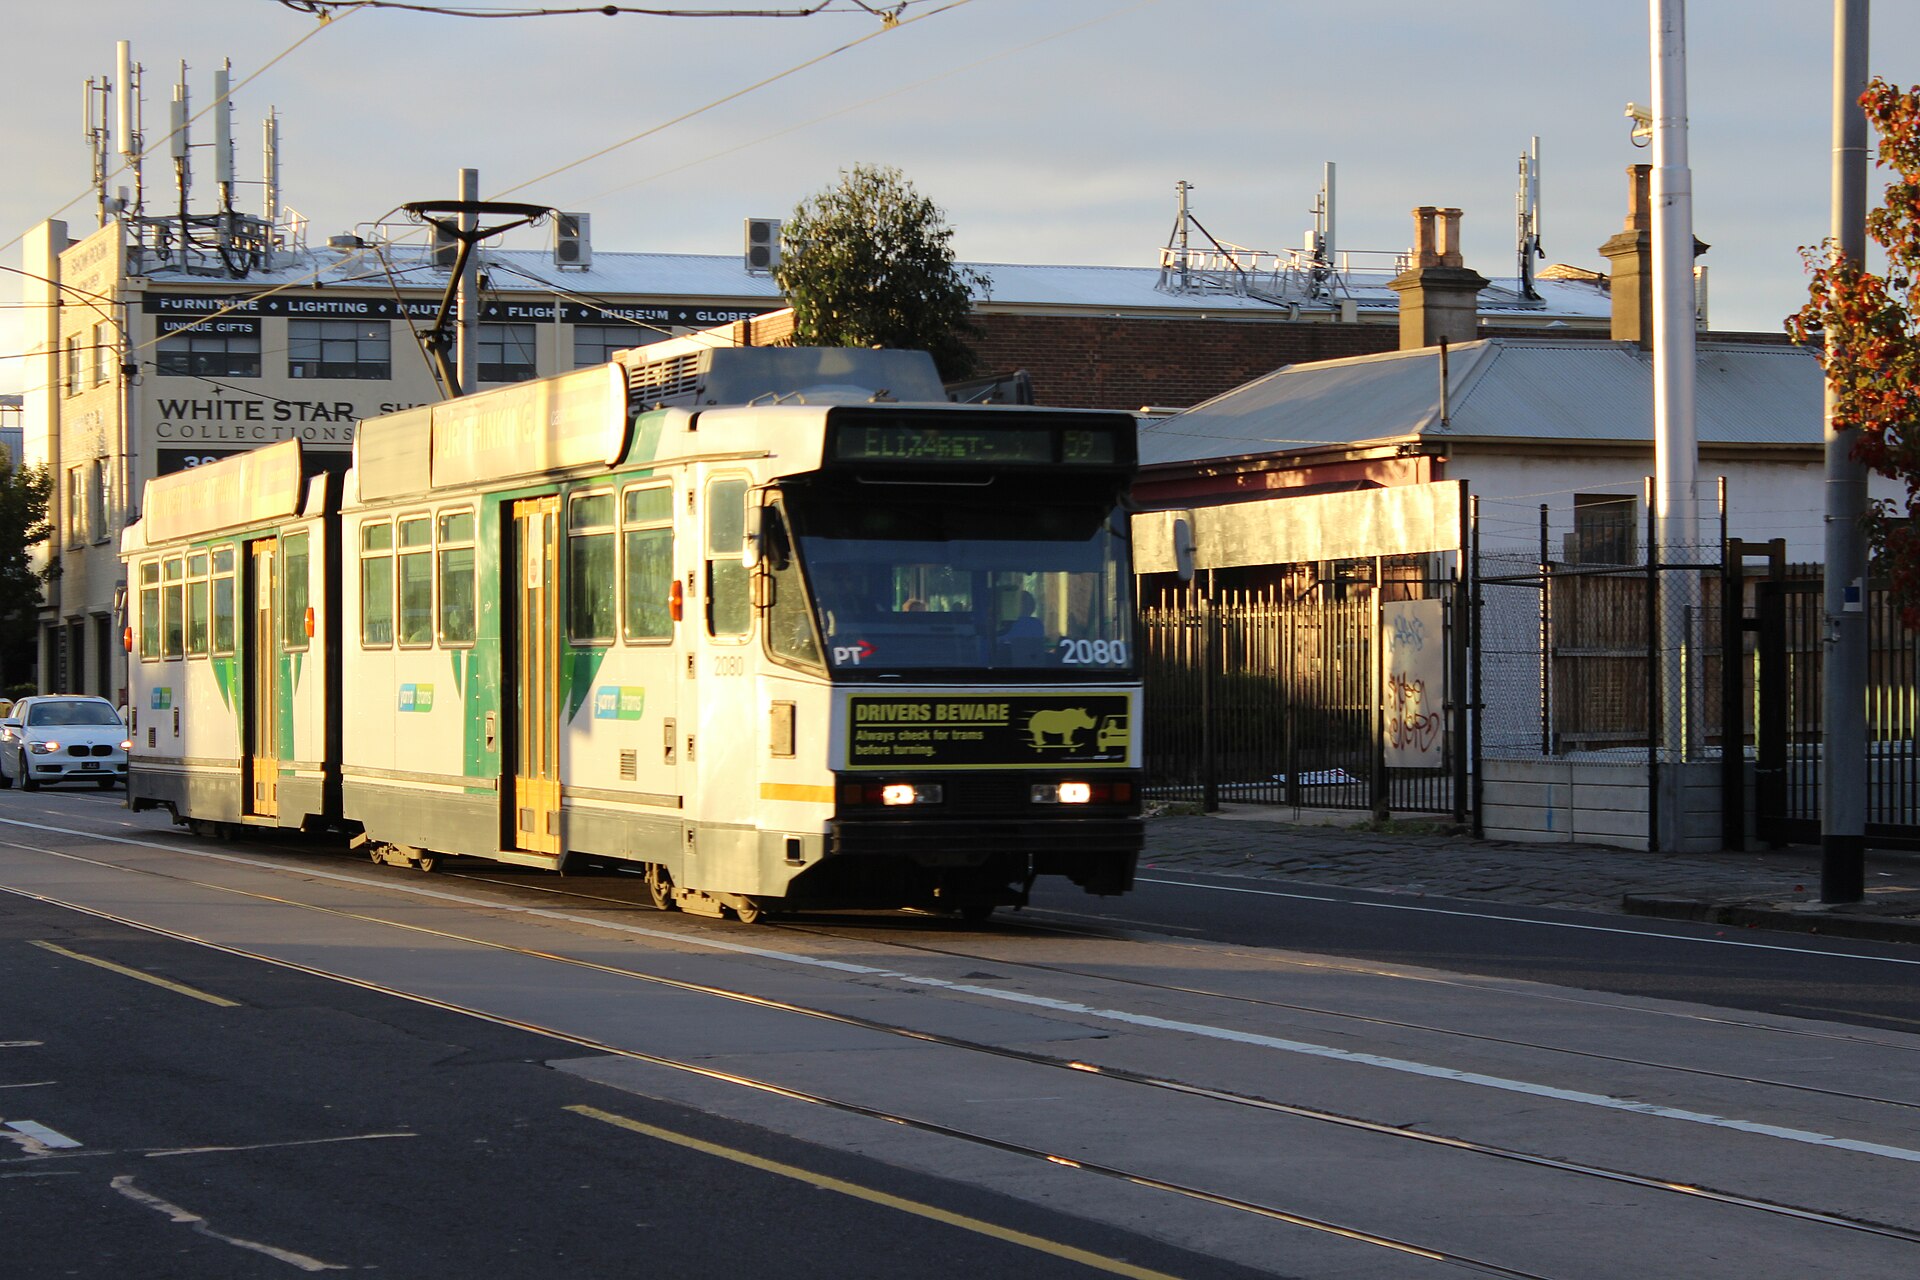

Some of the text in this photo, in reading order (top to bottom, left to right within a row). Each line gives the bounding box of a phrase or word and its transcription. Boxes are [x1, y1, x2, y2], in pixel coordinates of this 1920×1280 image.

[160, 298, 259, 311] FURNITURE
[288, 301, 369, 313] LIGHTING
[508, 307, 569, 318] FLIGHT
[601, 309, 669, 320] MUSEUM
[696, 311, 758, 322] GLOBES
[164, 321, 254, 333] UNIQUE GIFTS
[157, 399, 265, 421] WHITE
[273, 401, 356, 422] STAR
[156, 422, 353, 440] COLLECTIONS
[1059, 639, 1127, 665] 2080
[714, 656, 744, 676] 2080
[855, 703, 1010, 721] DRIVERS BEWARE
[855, 730, 984, 743] Always check for trams
[855, 744, 891, 756] before
